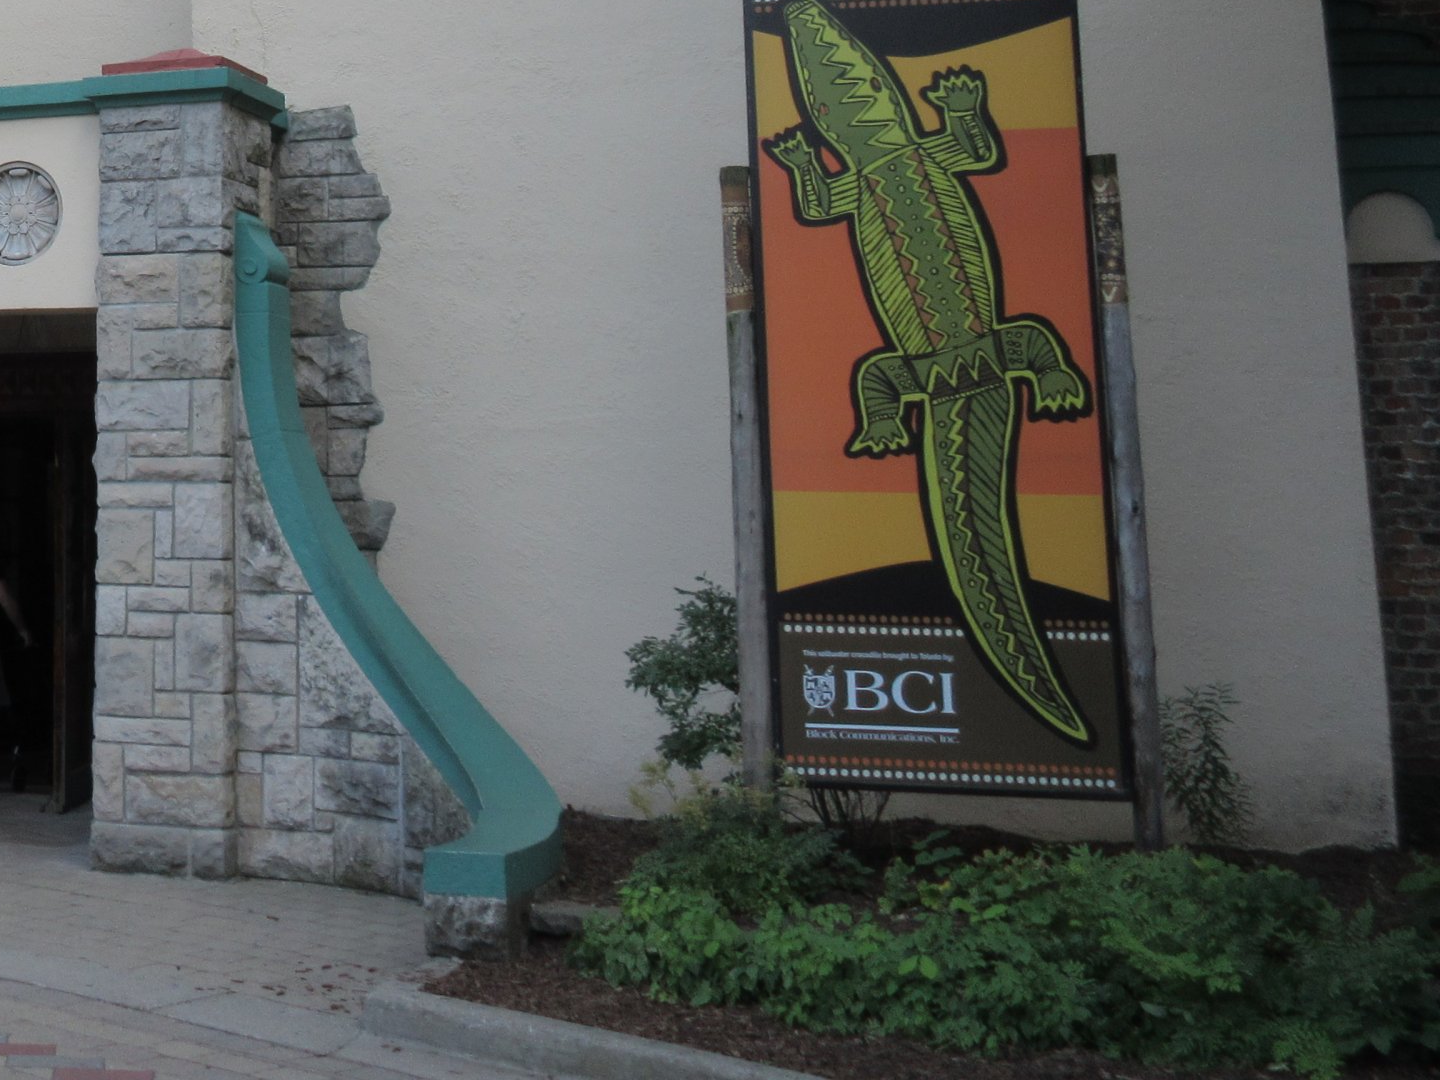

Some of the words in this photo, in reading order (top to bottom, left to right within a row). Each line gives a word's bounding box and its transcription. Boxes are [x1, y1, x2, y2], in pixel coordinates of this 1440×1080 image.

[844, 670, 957, 714] BCI
[806, 729, 838, 739] Block
[939, 734, 960, 743] Inc.
